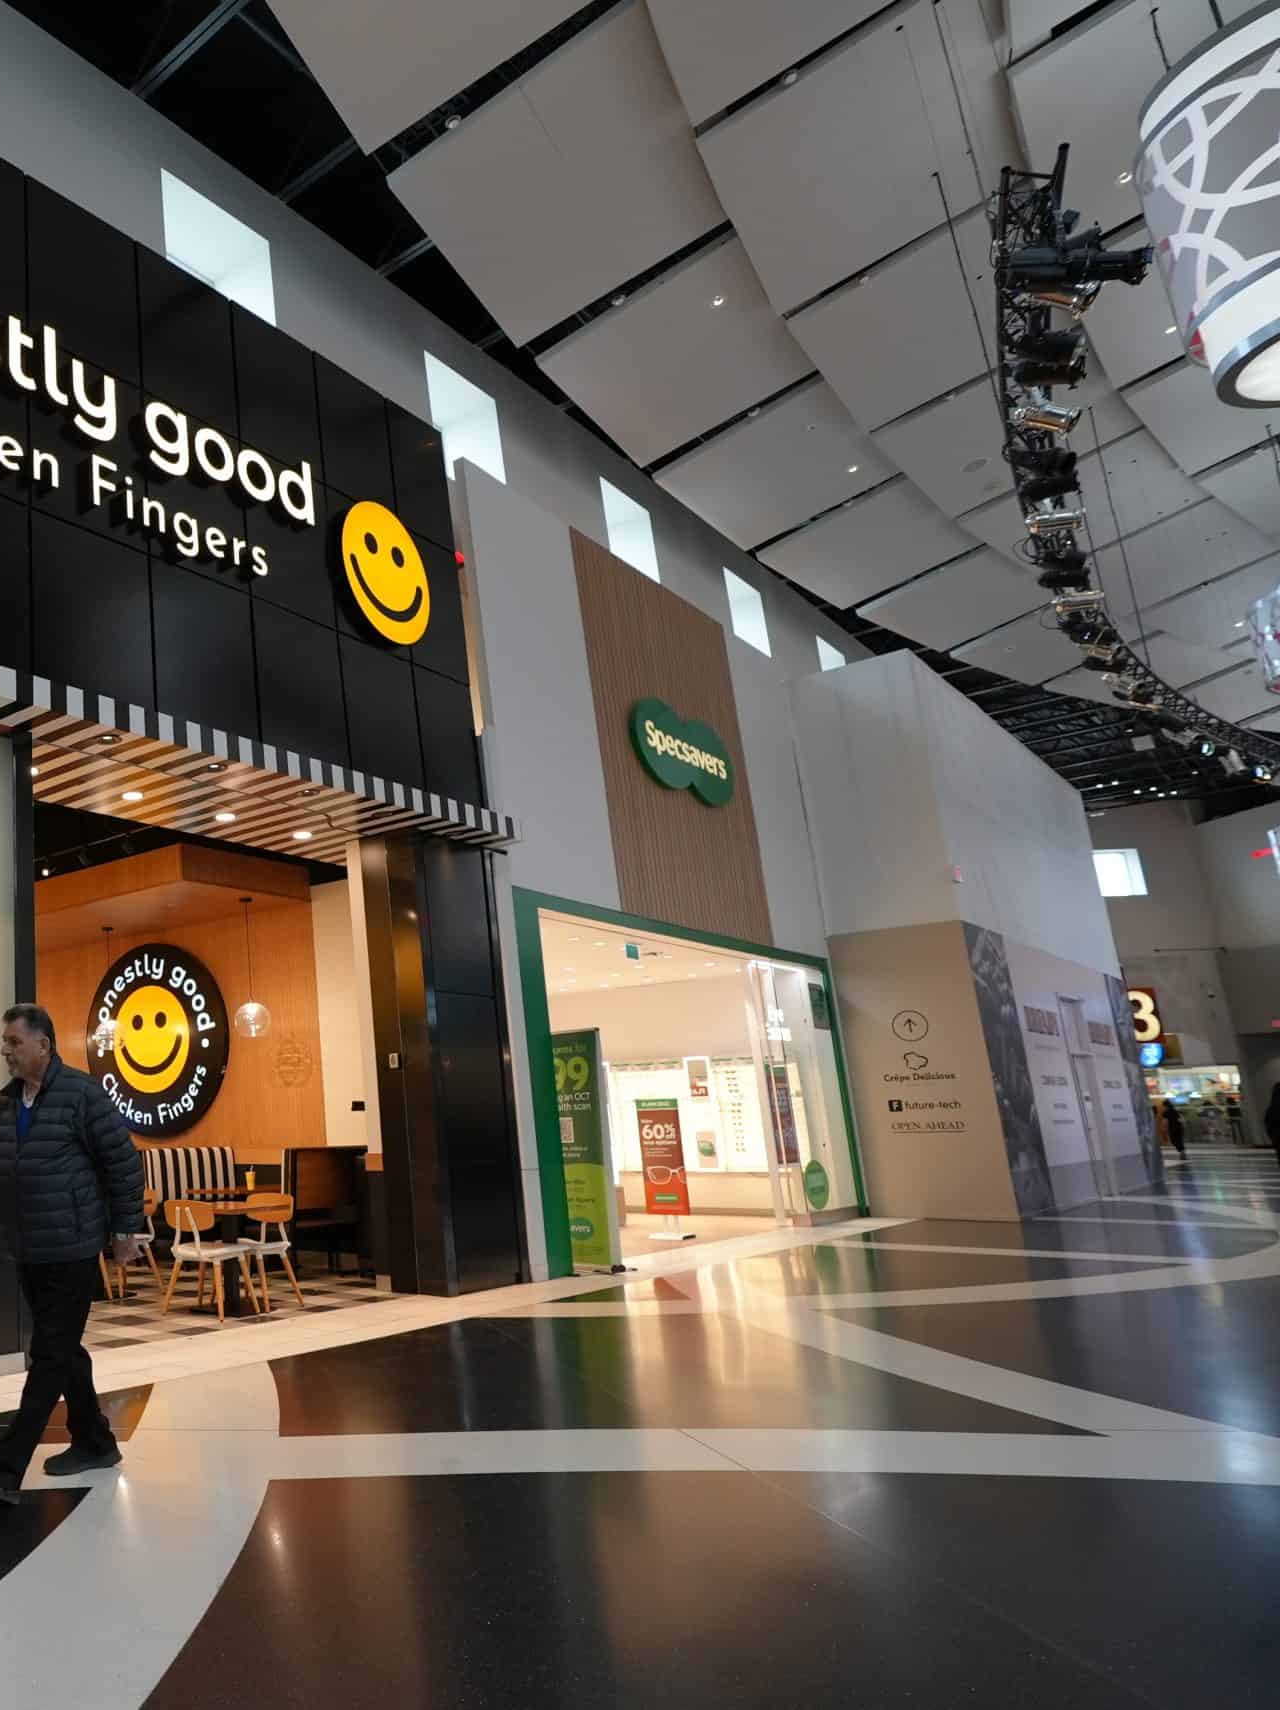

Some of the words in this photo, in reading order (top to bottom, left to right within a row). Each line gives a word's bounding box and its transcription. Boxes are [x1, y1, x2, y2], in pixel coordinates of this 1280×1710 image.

[145, 402, 315, 526] good
[92, 454, 269, 577] Fingers
[645, 719, 727, 780] Specsavers
[168, 966, 216, 1032] good
[1127, 990, 1161, 1042] 3
[102, 1073, 153, 1126] Chicken
[157, 1064, 207, 1124] Fingers
[913, 1072, 956, 1081] Delicious
